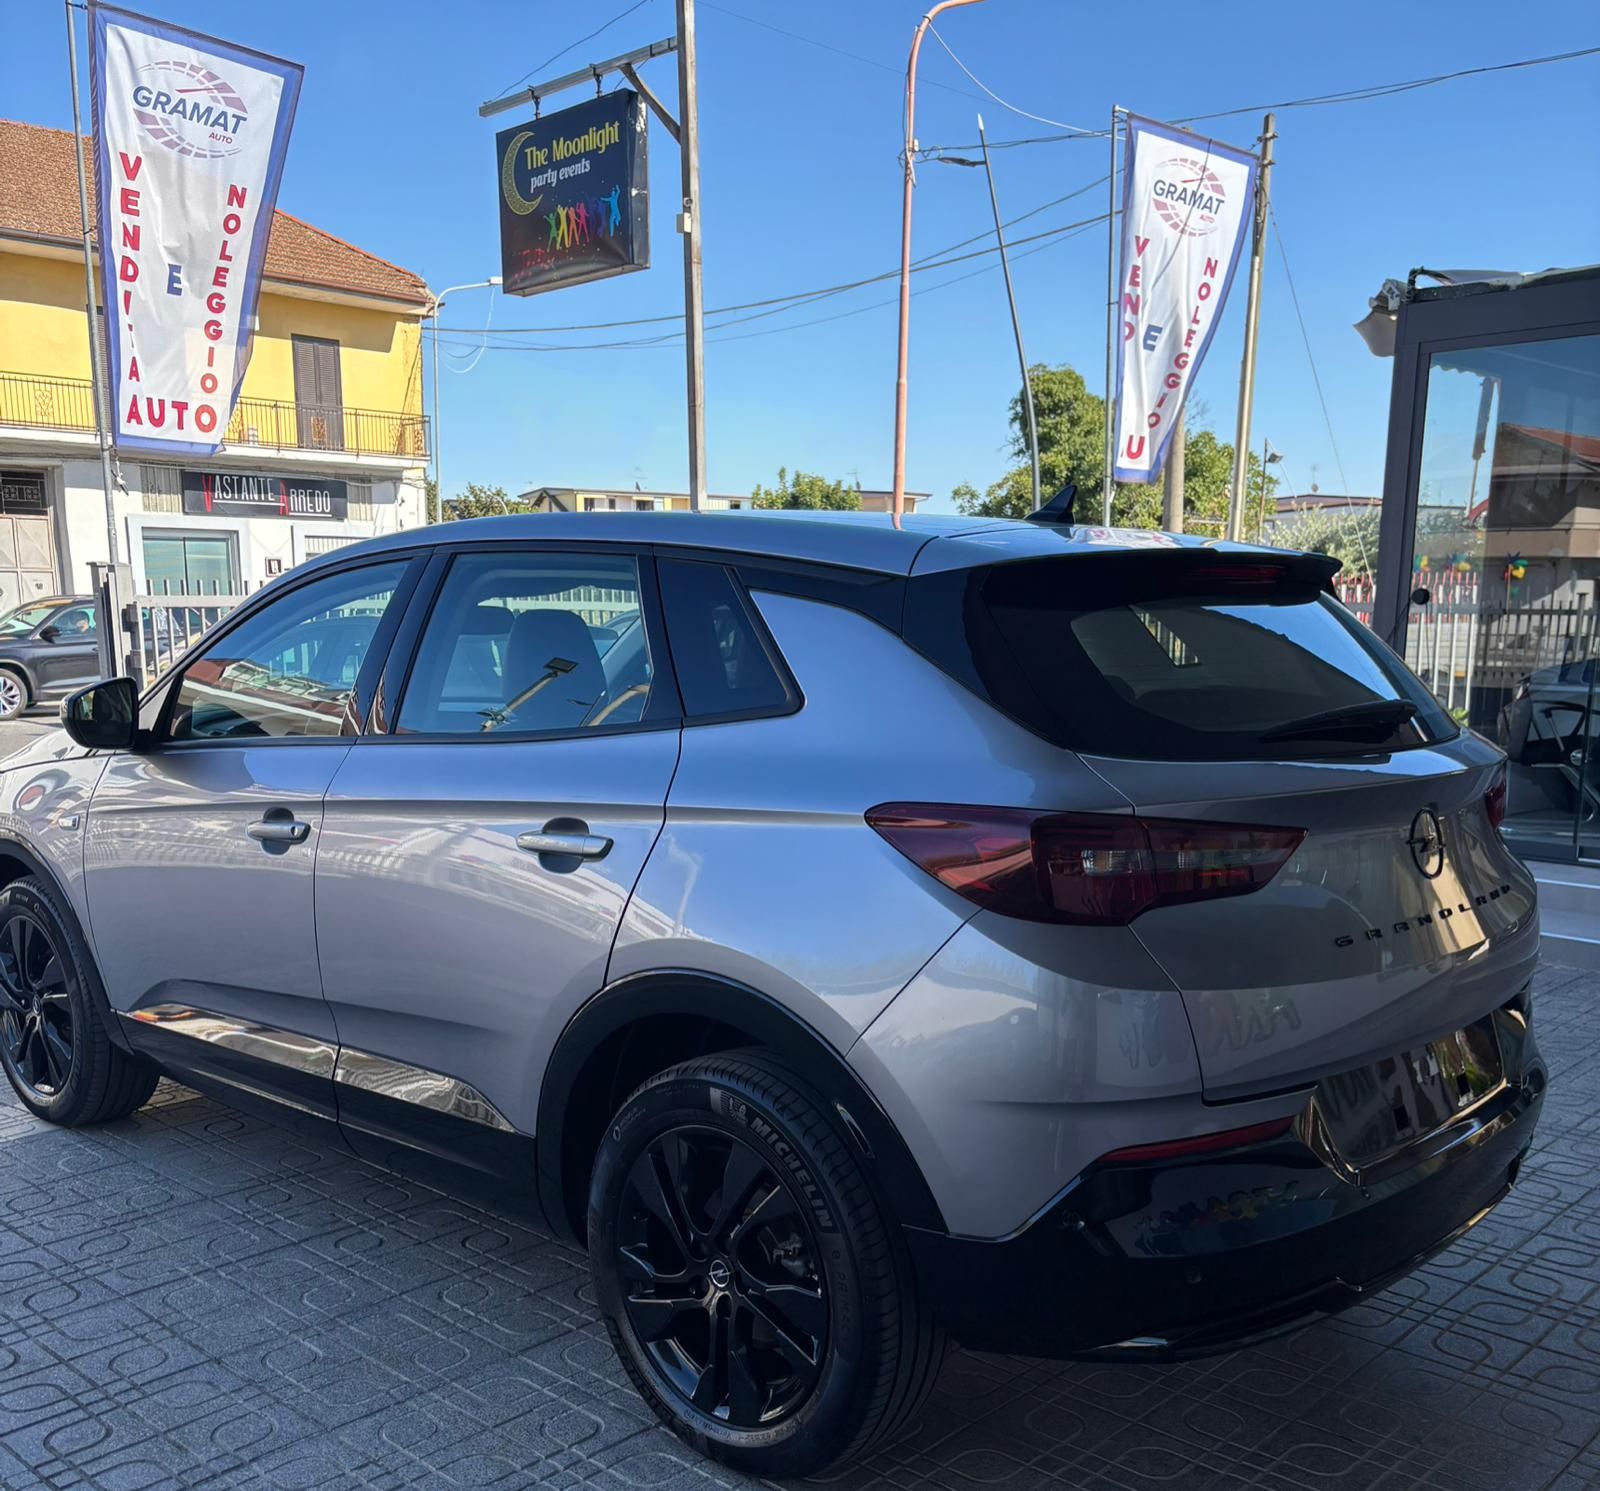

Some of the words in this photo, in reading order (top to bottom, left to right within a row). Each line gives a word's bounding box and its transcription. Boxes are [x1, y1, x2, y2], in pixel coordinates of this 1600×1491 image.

[132, 86, 247, 134] GRAMAT
[208, 132, 233, 144] AUTO
[524, 146, 549, 170] The
[552, 121, 620, 162] Moonlight
[530, 168, 557, 194] party
[559, 158, 591, 180] events
[1153, 179, 1225, 216] GRAMAT
[119, 152, 143, 382] VENDIA
[167, 264, 183, 296] E
[200, 184, 247, 394] NOLEGGIO
[1143, 324, 1163, 352] E
[1148, 257, 1219, 429] NOLEGGIO
[127, 394, 217, 433] AUTO
[202, 475, 275, 512] VASTANTE
[280, 480, 331, 517] ARREDO
[1334, 885, 1511, 948] GRANDLAND
[750, 1117, 833, 1227] MICHELIN
